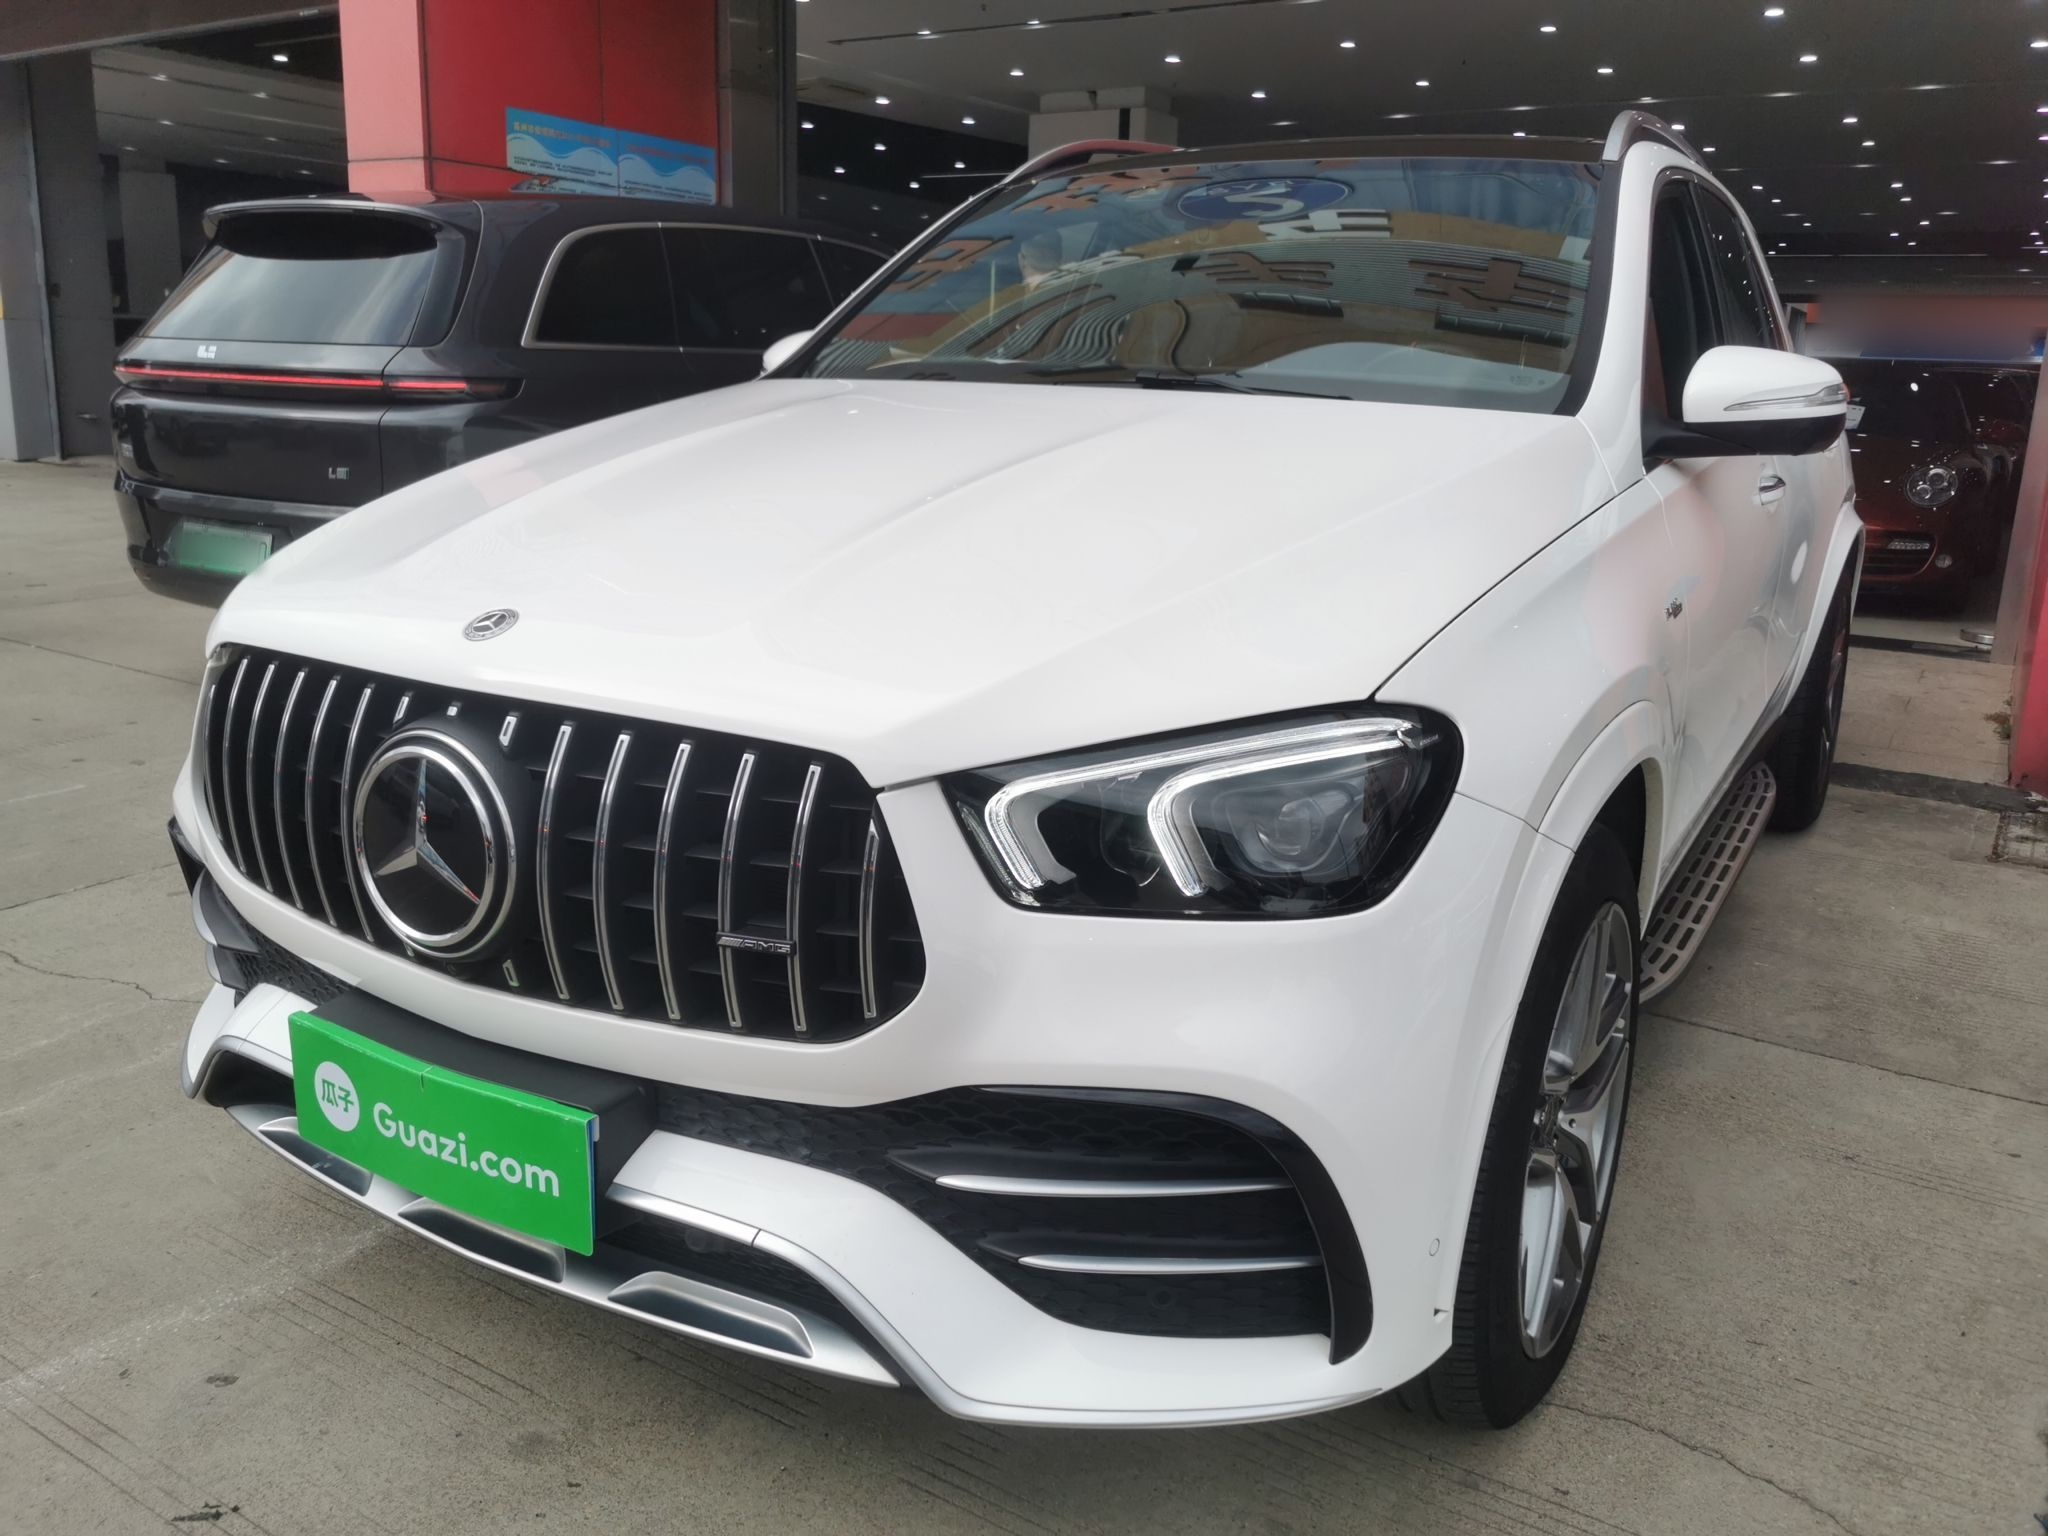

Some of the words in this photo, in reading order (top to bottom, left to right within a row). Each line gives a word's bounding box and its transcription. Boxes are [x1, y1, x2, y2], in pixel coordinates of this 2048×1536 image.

[740, 938, 791, 954] AMG
[321, 1078, 354, 1113] 瓜子
[373, 1102, 560, 1198] Guazi.com
